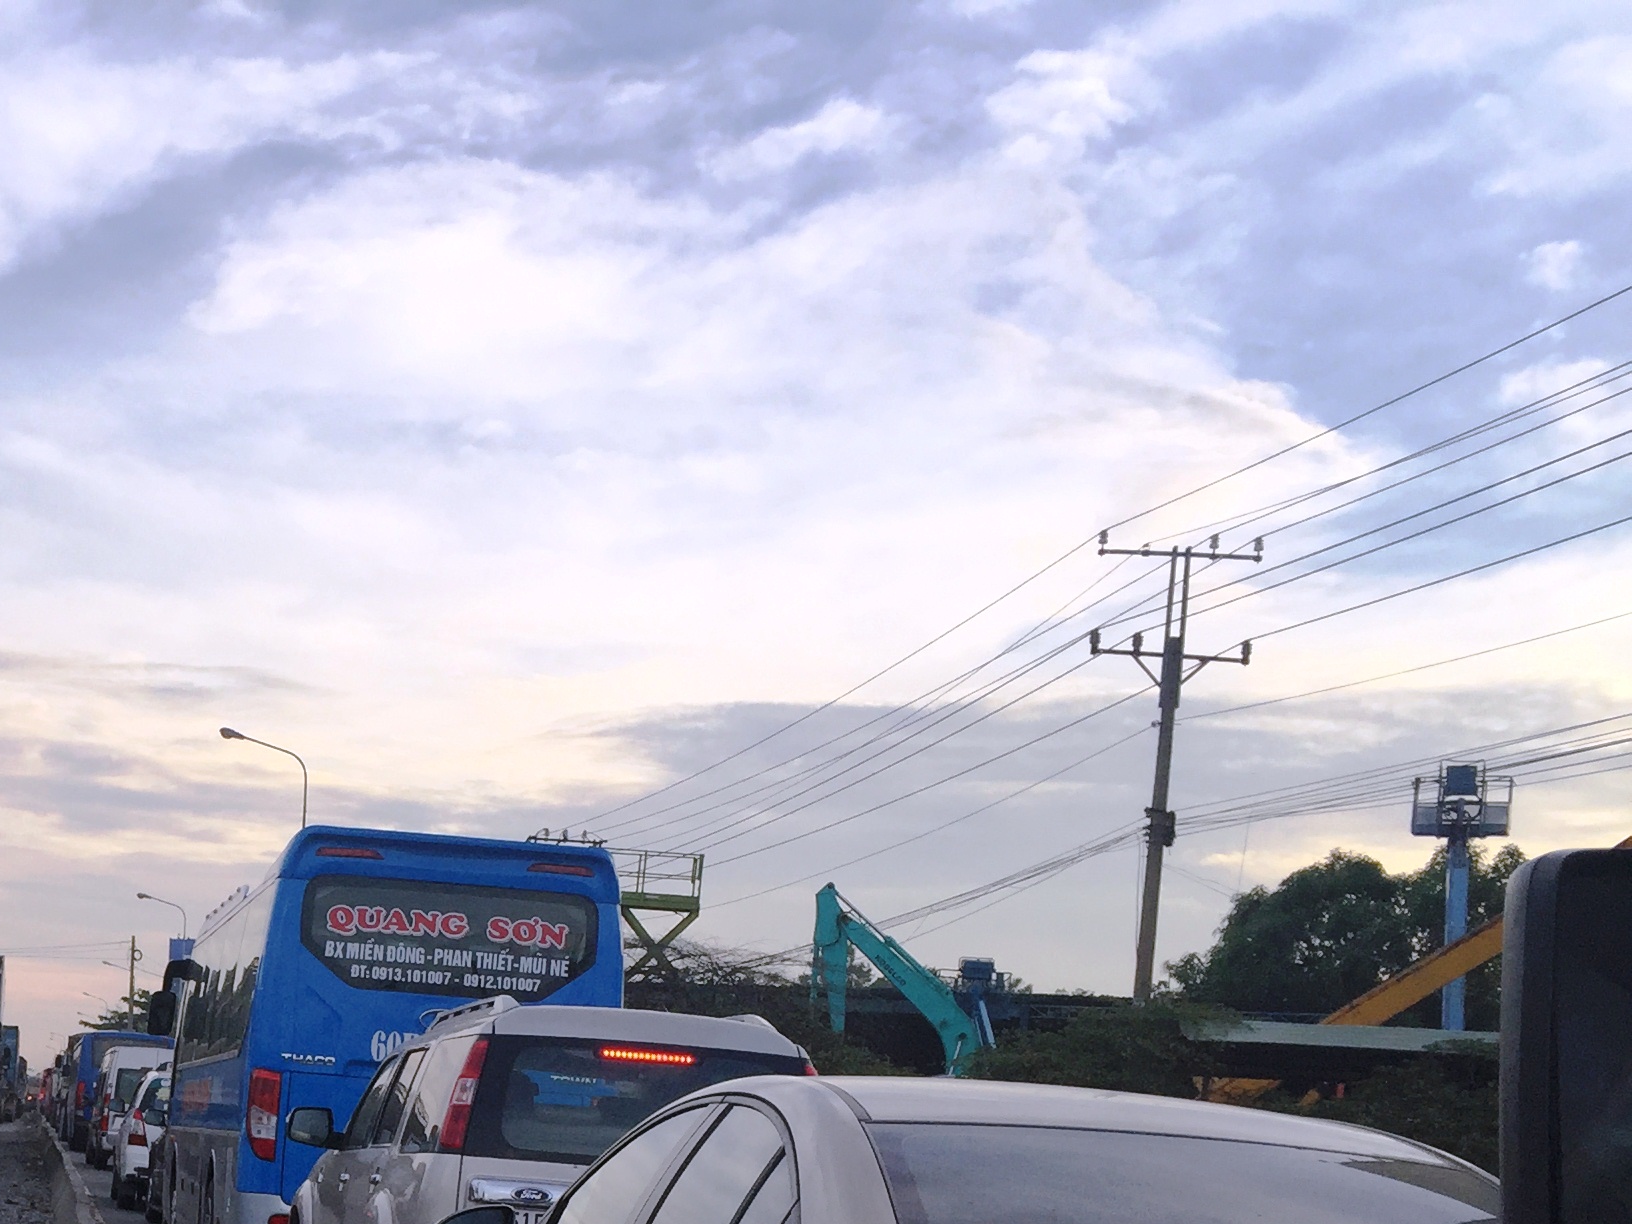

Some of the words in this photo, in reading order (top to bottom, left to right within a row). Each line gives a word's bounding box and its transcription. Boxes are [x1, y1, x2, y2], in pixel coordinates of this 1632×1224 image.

[326, 904, 469, 938] QUANG
[485, 916, 570, 950] SƠN
[324, 940, 344, 959] BX
[346, 938, 385, 962] MIỀN
[550, 954, 570, 978] NÉ
[463, 973, 541, 993] 0912.101007
[280, 1052, 336, 1066] THACO
